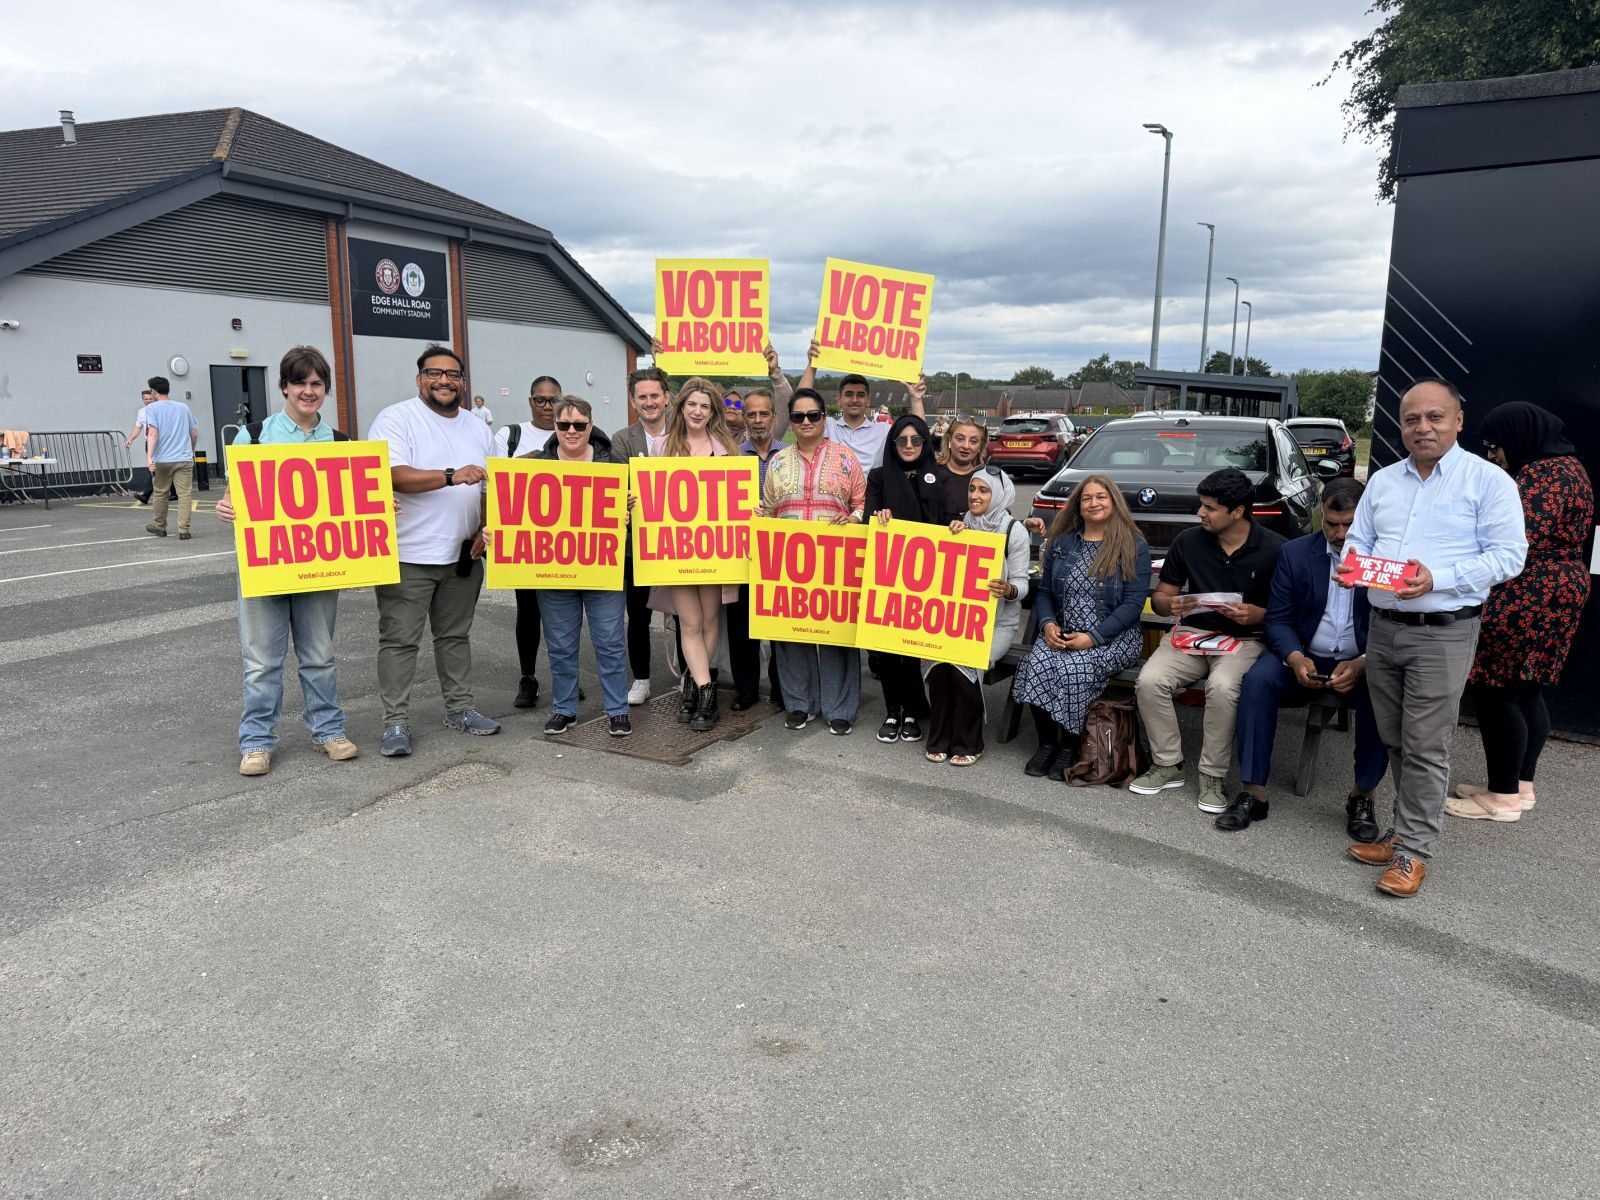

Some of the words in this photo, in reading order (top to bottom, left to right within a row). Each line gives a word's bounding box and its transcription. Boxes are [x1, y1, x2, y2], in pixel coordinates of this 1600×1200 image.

[371, 295, 391, 305] EDGE
[392, 297, 410, 307] HALL
[411, 300, 431, 309] ROAD
[372, 306, 406, 316] COMMUNITY
[407, 310, 431, 319] STADIUM
[662, 270, 762, 318] VOTE
[830, 270, 926, 328] VOTE
[661, 321, 763, 353] LABOUR
[820, 317, 920, 361] LABOUR
[237, 455, 385, 521] VOTE
[495, 472, 620, 528] VOTE
[637, 469, 752, 523] VOTE
[244, 518, 390, 567] LABOUR
[494, 530, 618, 566] LABOUR
[639, 525, 750, 560] LABOUR
[757, 530, 868, 588] VOTE
[297, 572, 316, 580] Vote
[321, 570, 347, 578] Labour
[874, 531, 996, 603] VOTE
[1361, 569, 1376, 582] OF
[1383, 561, 1405, 575] ONE
[864, 588, 988, 643] LABOUR
